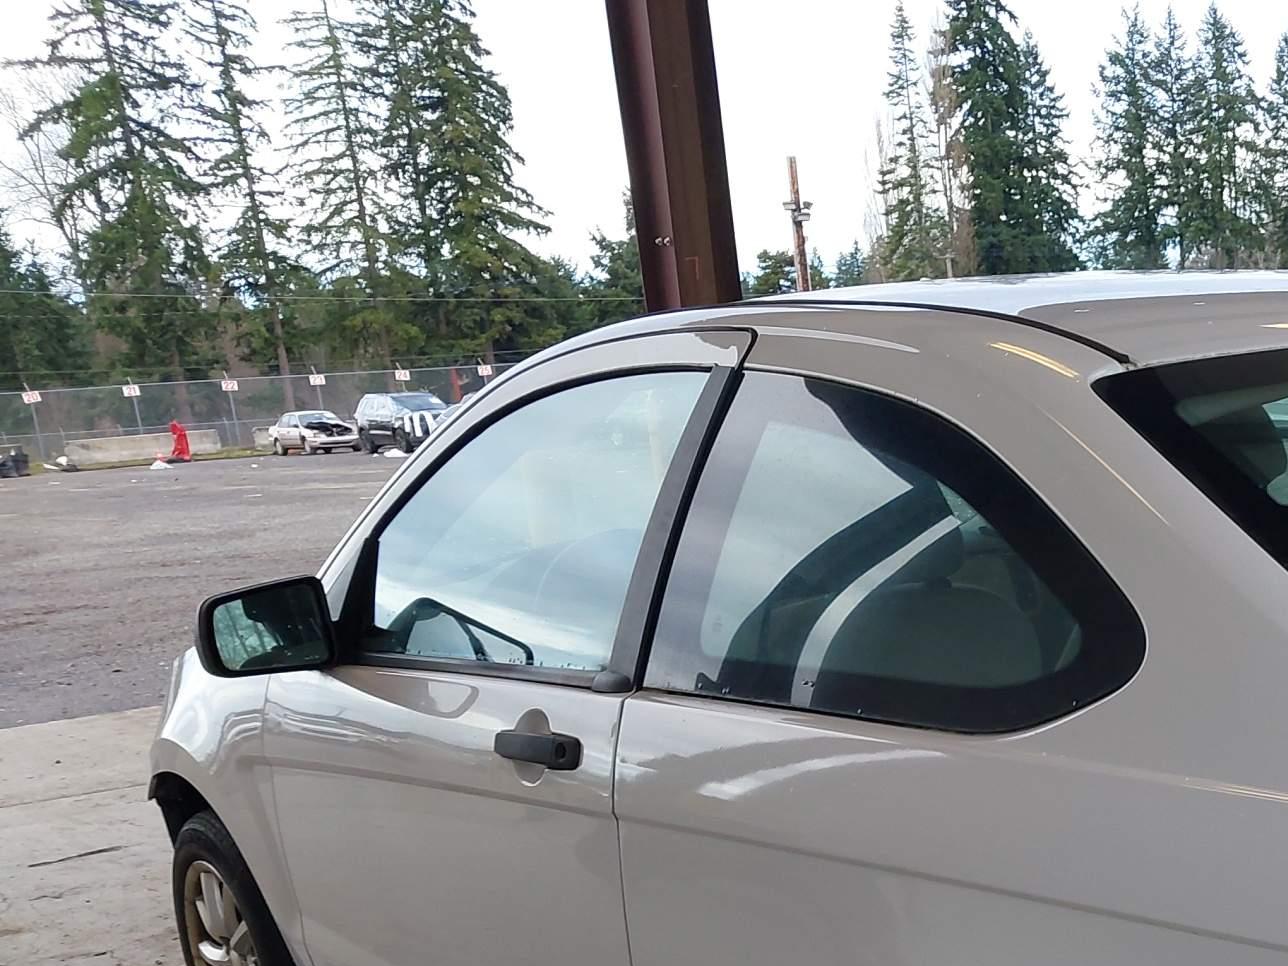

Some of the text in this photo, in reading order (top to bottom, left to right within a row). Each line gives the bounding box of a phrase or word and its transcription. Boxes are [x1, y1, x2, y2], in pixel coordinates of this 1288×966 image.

[397, 370, 408, 379] 24
[479, 366, 490, 375] 25
[223, 381, 236, 390] 22
[126, 386, 137, 396] 21
[25, 391, 39, 402] 20
